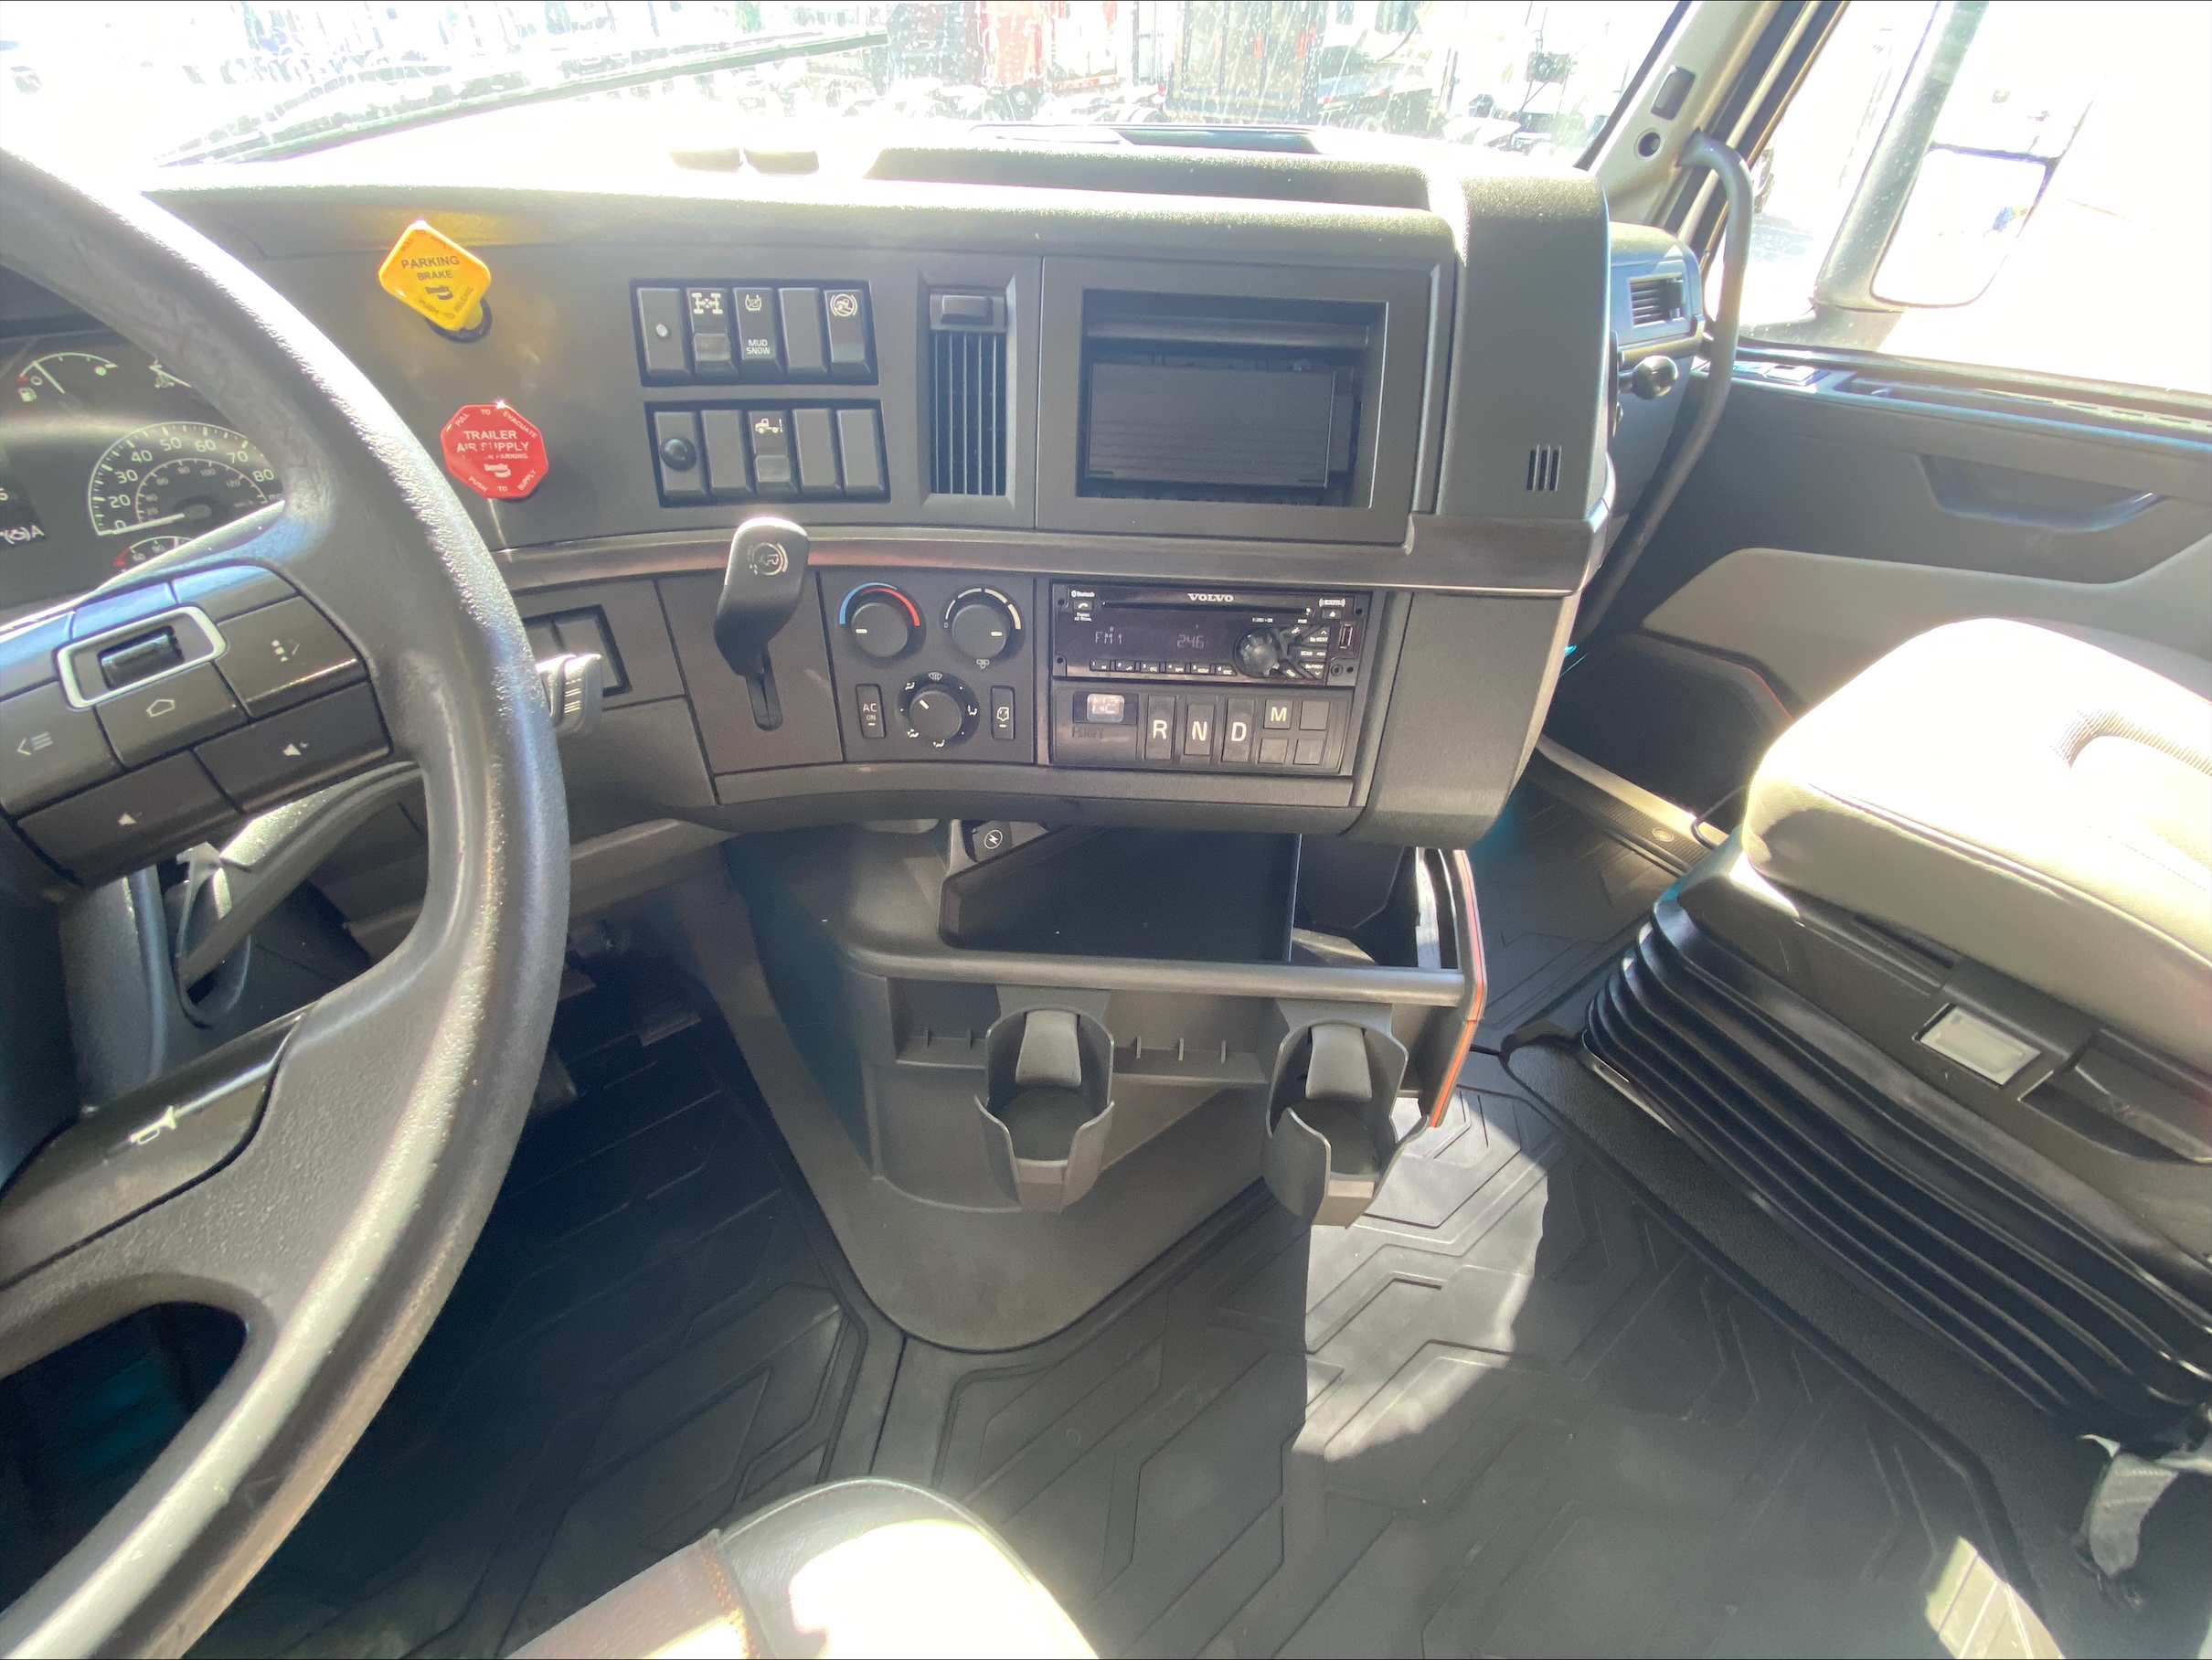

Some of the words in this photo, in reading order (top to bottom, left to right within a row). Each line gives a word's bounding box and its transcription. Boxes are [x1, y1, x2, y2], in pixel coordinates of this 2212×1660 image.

[400, 255, 460, 270] PARKING
[417, 270, 453, 281] BRAKE
[748, 338, 768, 346] MUD
[746, 346, 771, 355] SNOW
[455, 412, 470, 427] PULL
[503, 410, 537, 439] EVACUATE
[463, 430, 517, 441] TRAILER
[159, 436, 182, 452] 50
[195, 439, 217, 453] 60
[457, 442, 478, 453] AIR
[131, 450, 153, 463] 40
[226, 451, 249, 464] 70
[114, 469, 138, 484] 30
[252, 468, 274, 483] 80
[468, 476, 488, 493] PUSH
[517, 469, 537, 491] SUPPLY
[108, 494, 131, 509] 20
[1187, 592, 1234, 602] VOLVO
[863, 703, 877, 712] AC
[1271, 707, 1287, 722] M
[1153, 719, 1168, 740] R
[1192, 720, 1207, 741] N
[1230, 721, 1247, 742] D
